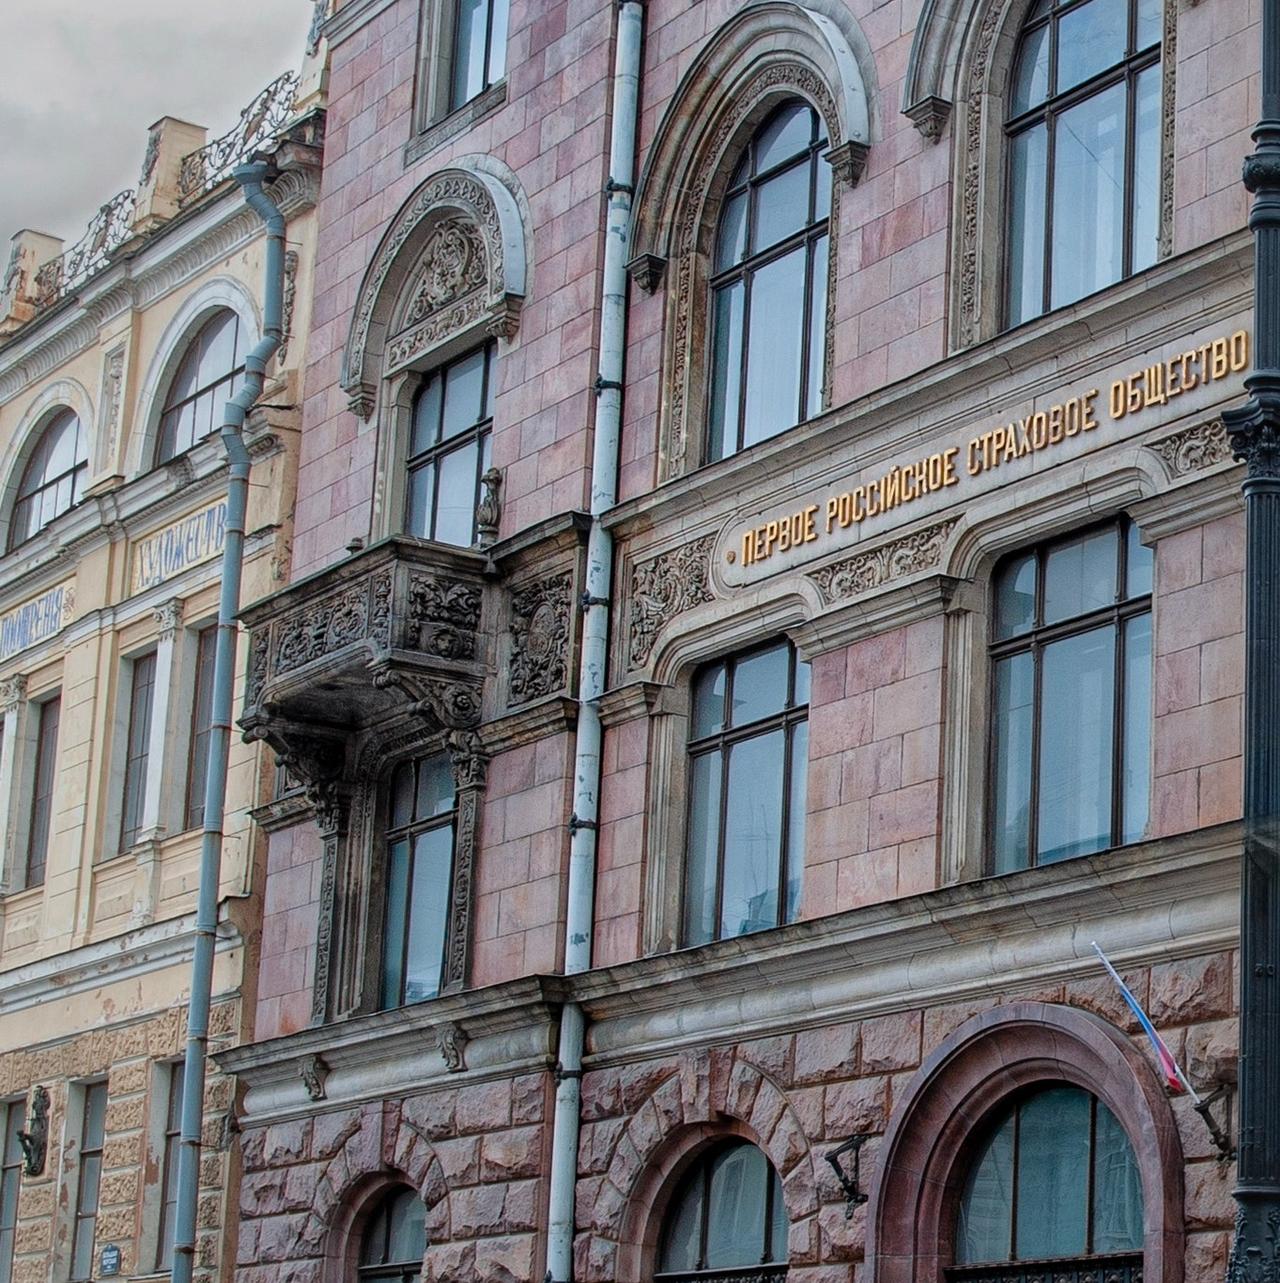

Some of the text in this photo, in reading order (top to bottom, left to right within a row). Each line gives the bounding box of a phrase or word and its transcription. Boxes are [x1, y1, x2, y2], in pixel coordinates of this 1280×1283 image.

[741, 504, 819, 566] ПЕРВОЕ
[825, 446, 960, 534] РОССІЙСКОЕ
[966, 389, 1099, 476] СТРАХОВОЕ
[1109, 329, 1249, 420] ОБЩЕСТВО
